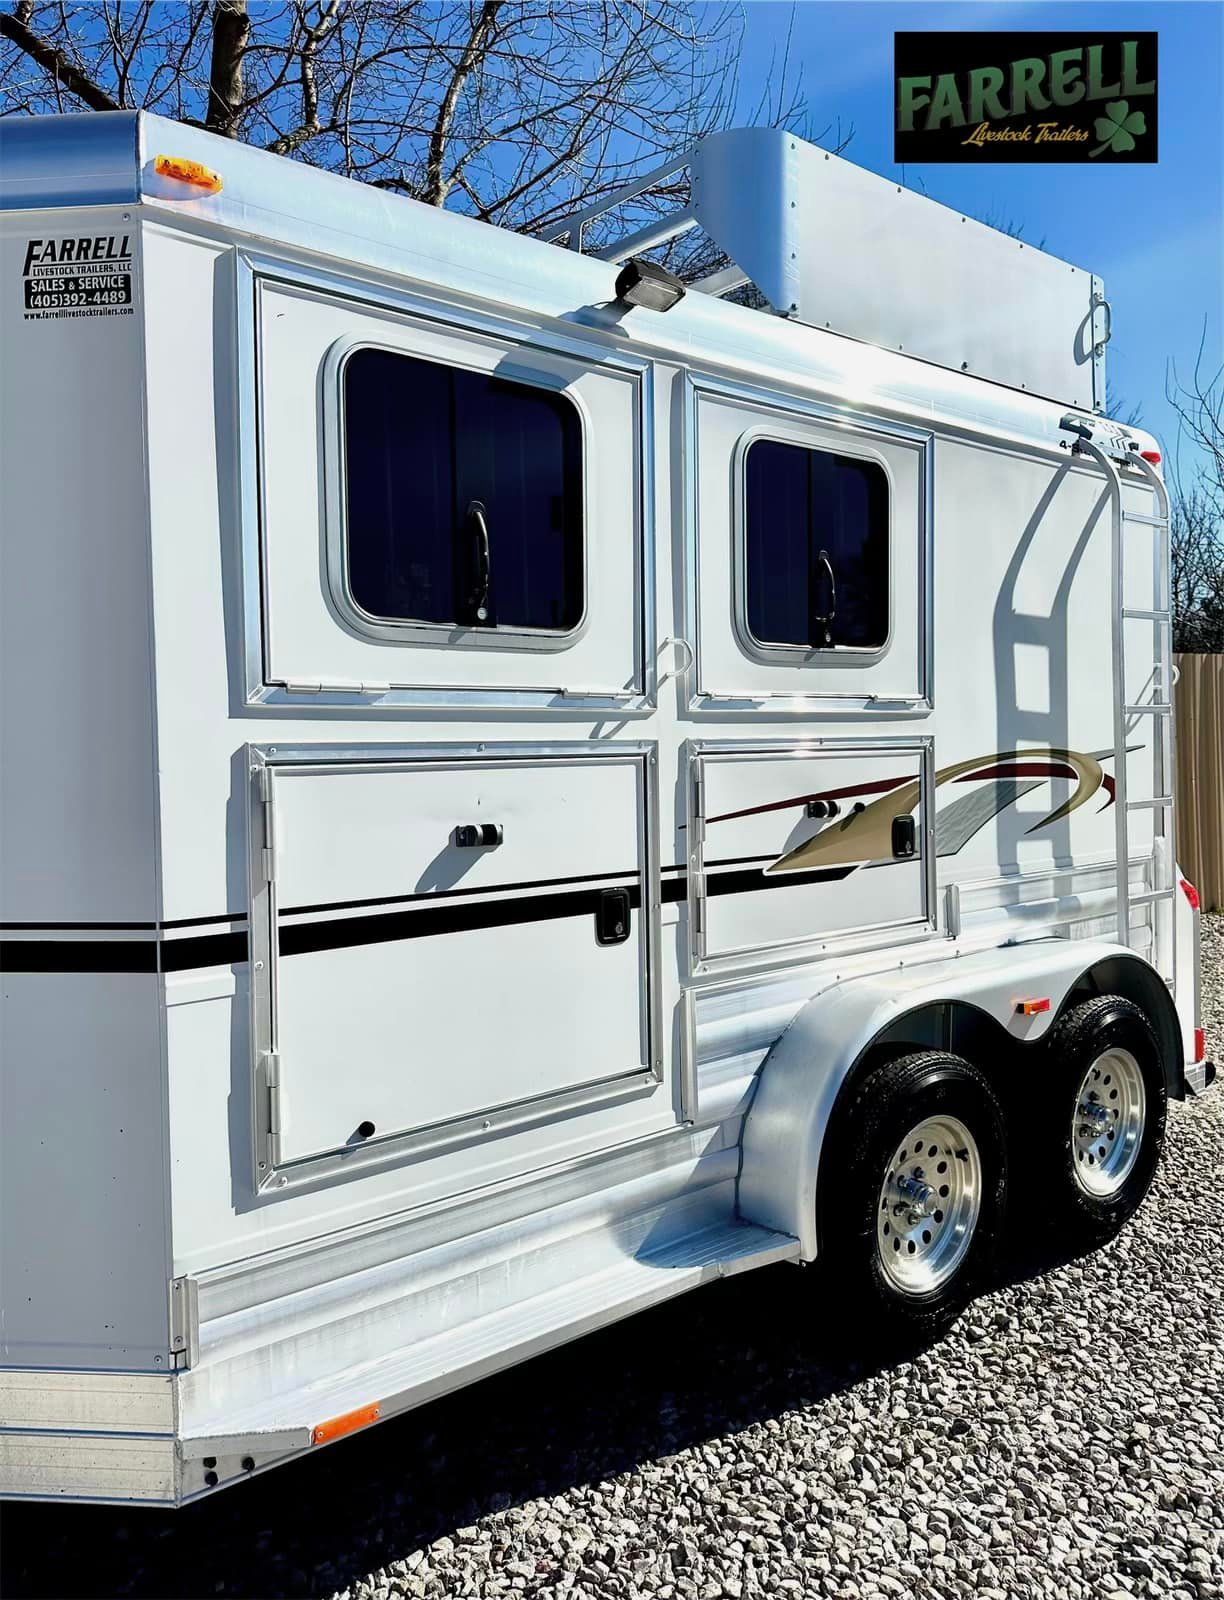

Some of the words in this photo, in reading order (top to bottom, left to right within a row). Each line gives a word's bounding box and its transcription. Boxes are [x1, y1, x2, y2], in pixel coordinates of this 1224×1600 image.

[23, 235, 132, 276] FARRELL
[33, 265, 75, 276] LIVESTOCK
[77, 264, 117, 275] TRAILERS,
[118, 263, 132, 272] LLC
[31, 279, 65, 292] SALES
[68, 281, 75, 290] &
[78, 276, 125, 290] SERVICE
[30, 290, 126, 307] (405)392-4489
